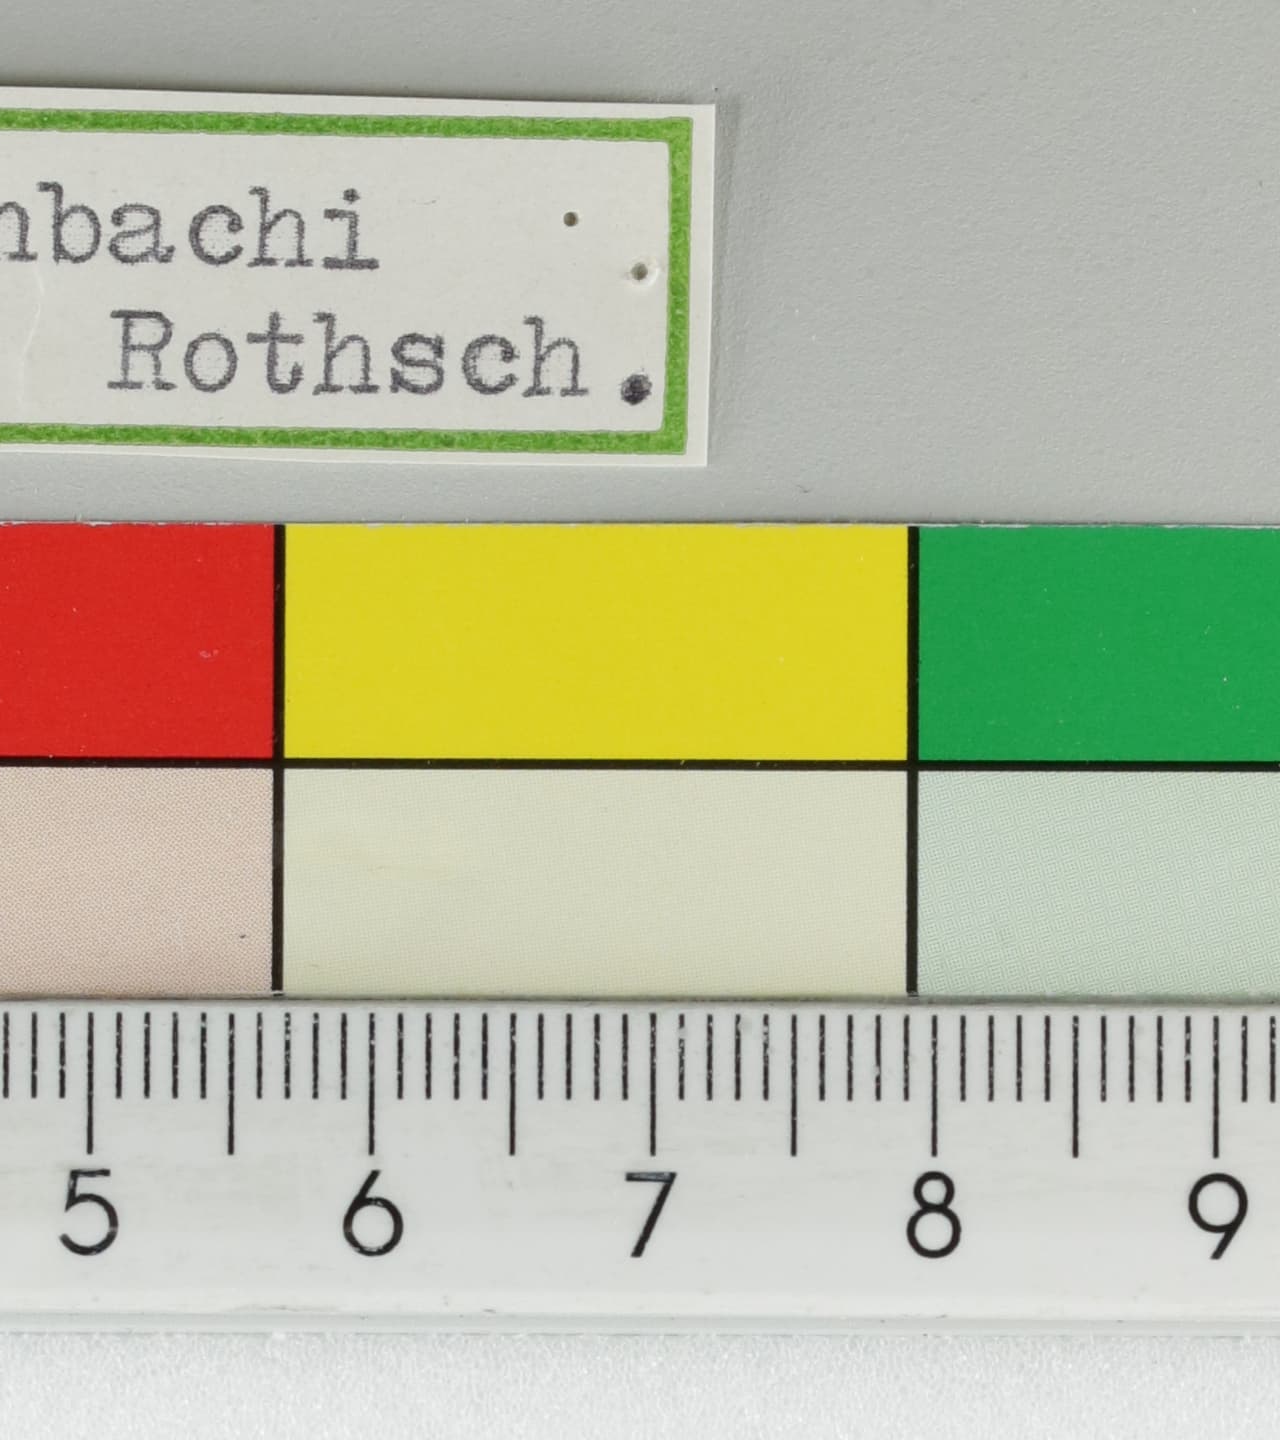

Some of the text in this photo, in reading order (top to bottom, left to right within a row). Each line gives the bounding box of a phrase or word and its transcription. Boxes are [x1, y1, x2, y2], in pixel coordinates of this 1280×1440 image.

[106, 308, 653, 407] Rothsch.
[59, 1167, 119, 1257] 5
[342, 1169, 404, 1257] 6
[624, 1171, 678, 1258] 7
[905, 1170, 962, 1259] 8
[1187, 1172, 1249, 1261] 9
